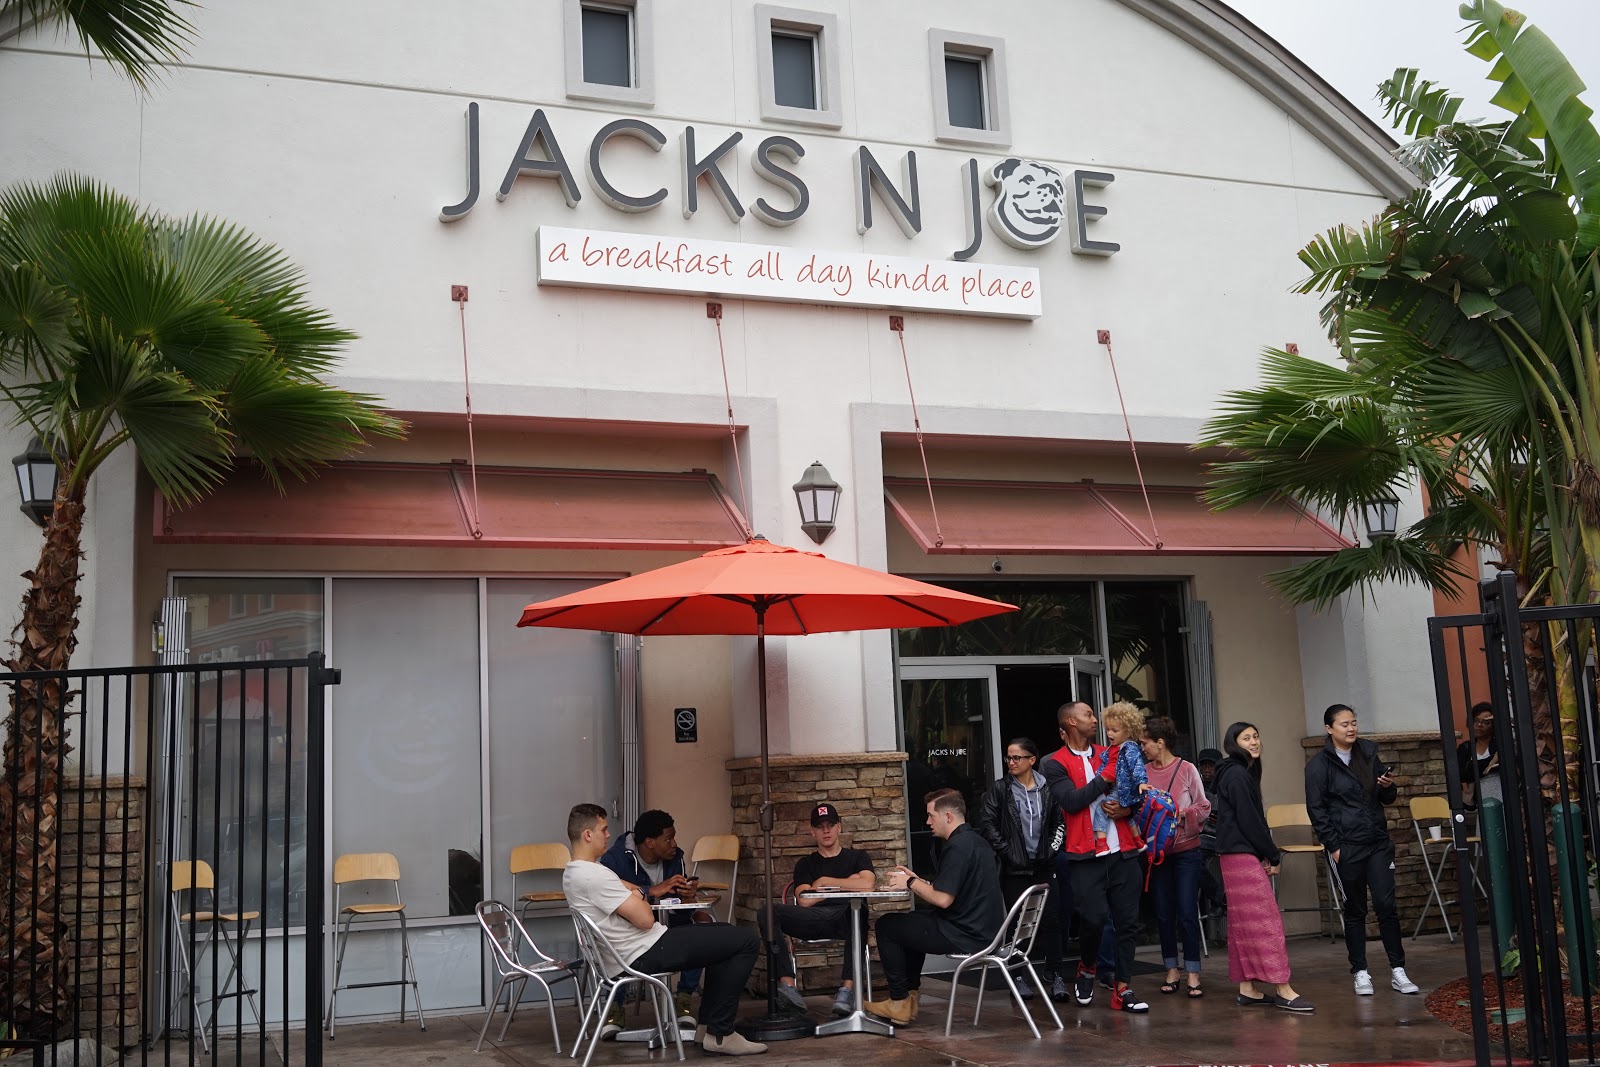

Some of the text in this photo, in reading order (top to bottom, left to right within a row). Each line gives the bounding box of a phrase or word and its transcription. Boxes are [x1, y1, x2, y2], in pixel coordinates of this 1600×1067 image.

[440, 102, 810, 227] JACKS
[853, 145, 922, 239] N
[548, 237, 1034, 305] a breakfast all day kinda place
[928, 748, 948, 757] JACKS
[949, 748, 955, 756] N
